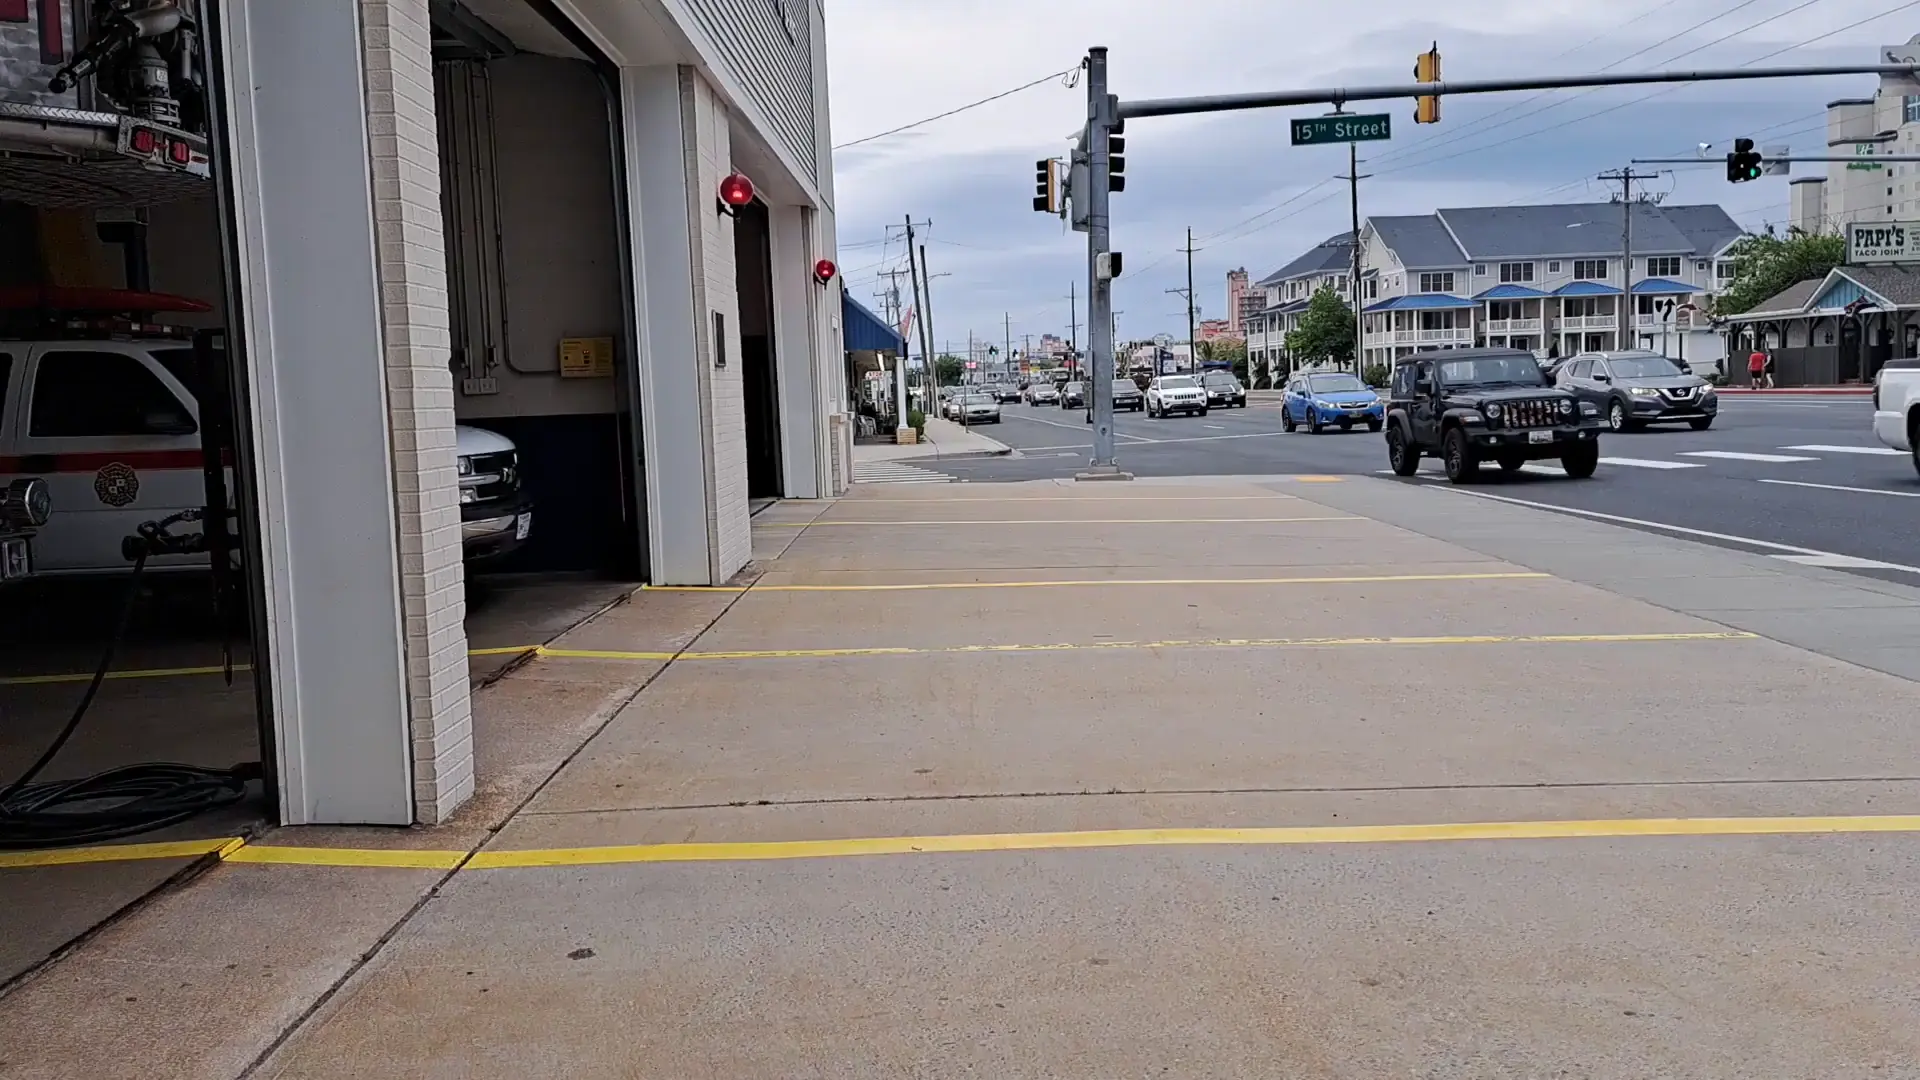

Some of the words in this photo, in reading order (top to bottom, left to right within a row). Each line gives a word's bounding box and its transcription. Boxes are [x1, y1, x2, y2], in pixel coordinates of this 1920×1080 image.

[1295, 124, 1327, 140] 15TH
[1335, 120, 1387, 138] Street
[1855, 225, 1904, 247] PAPI'S
[1855, 249, 1877, 257] TACO
